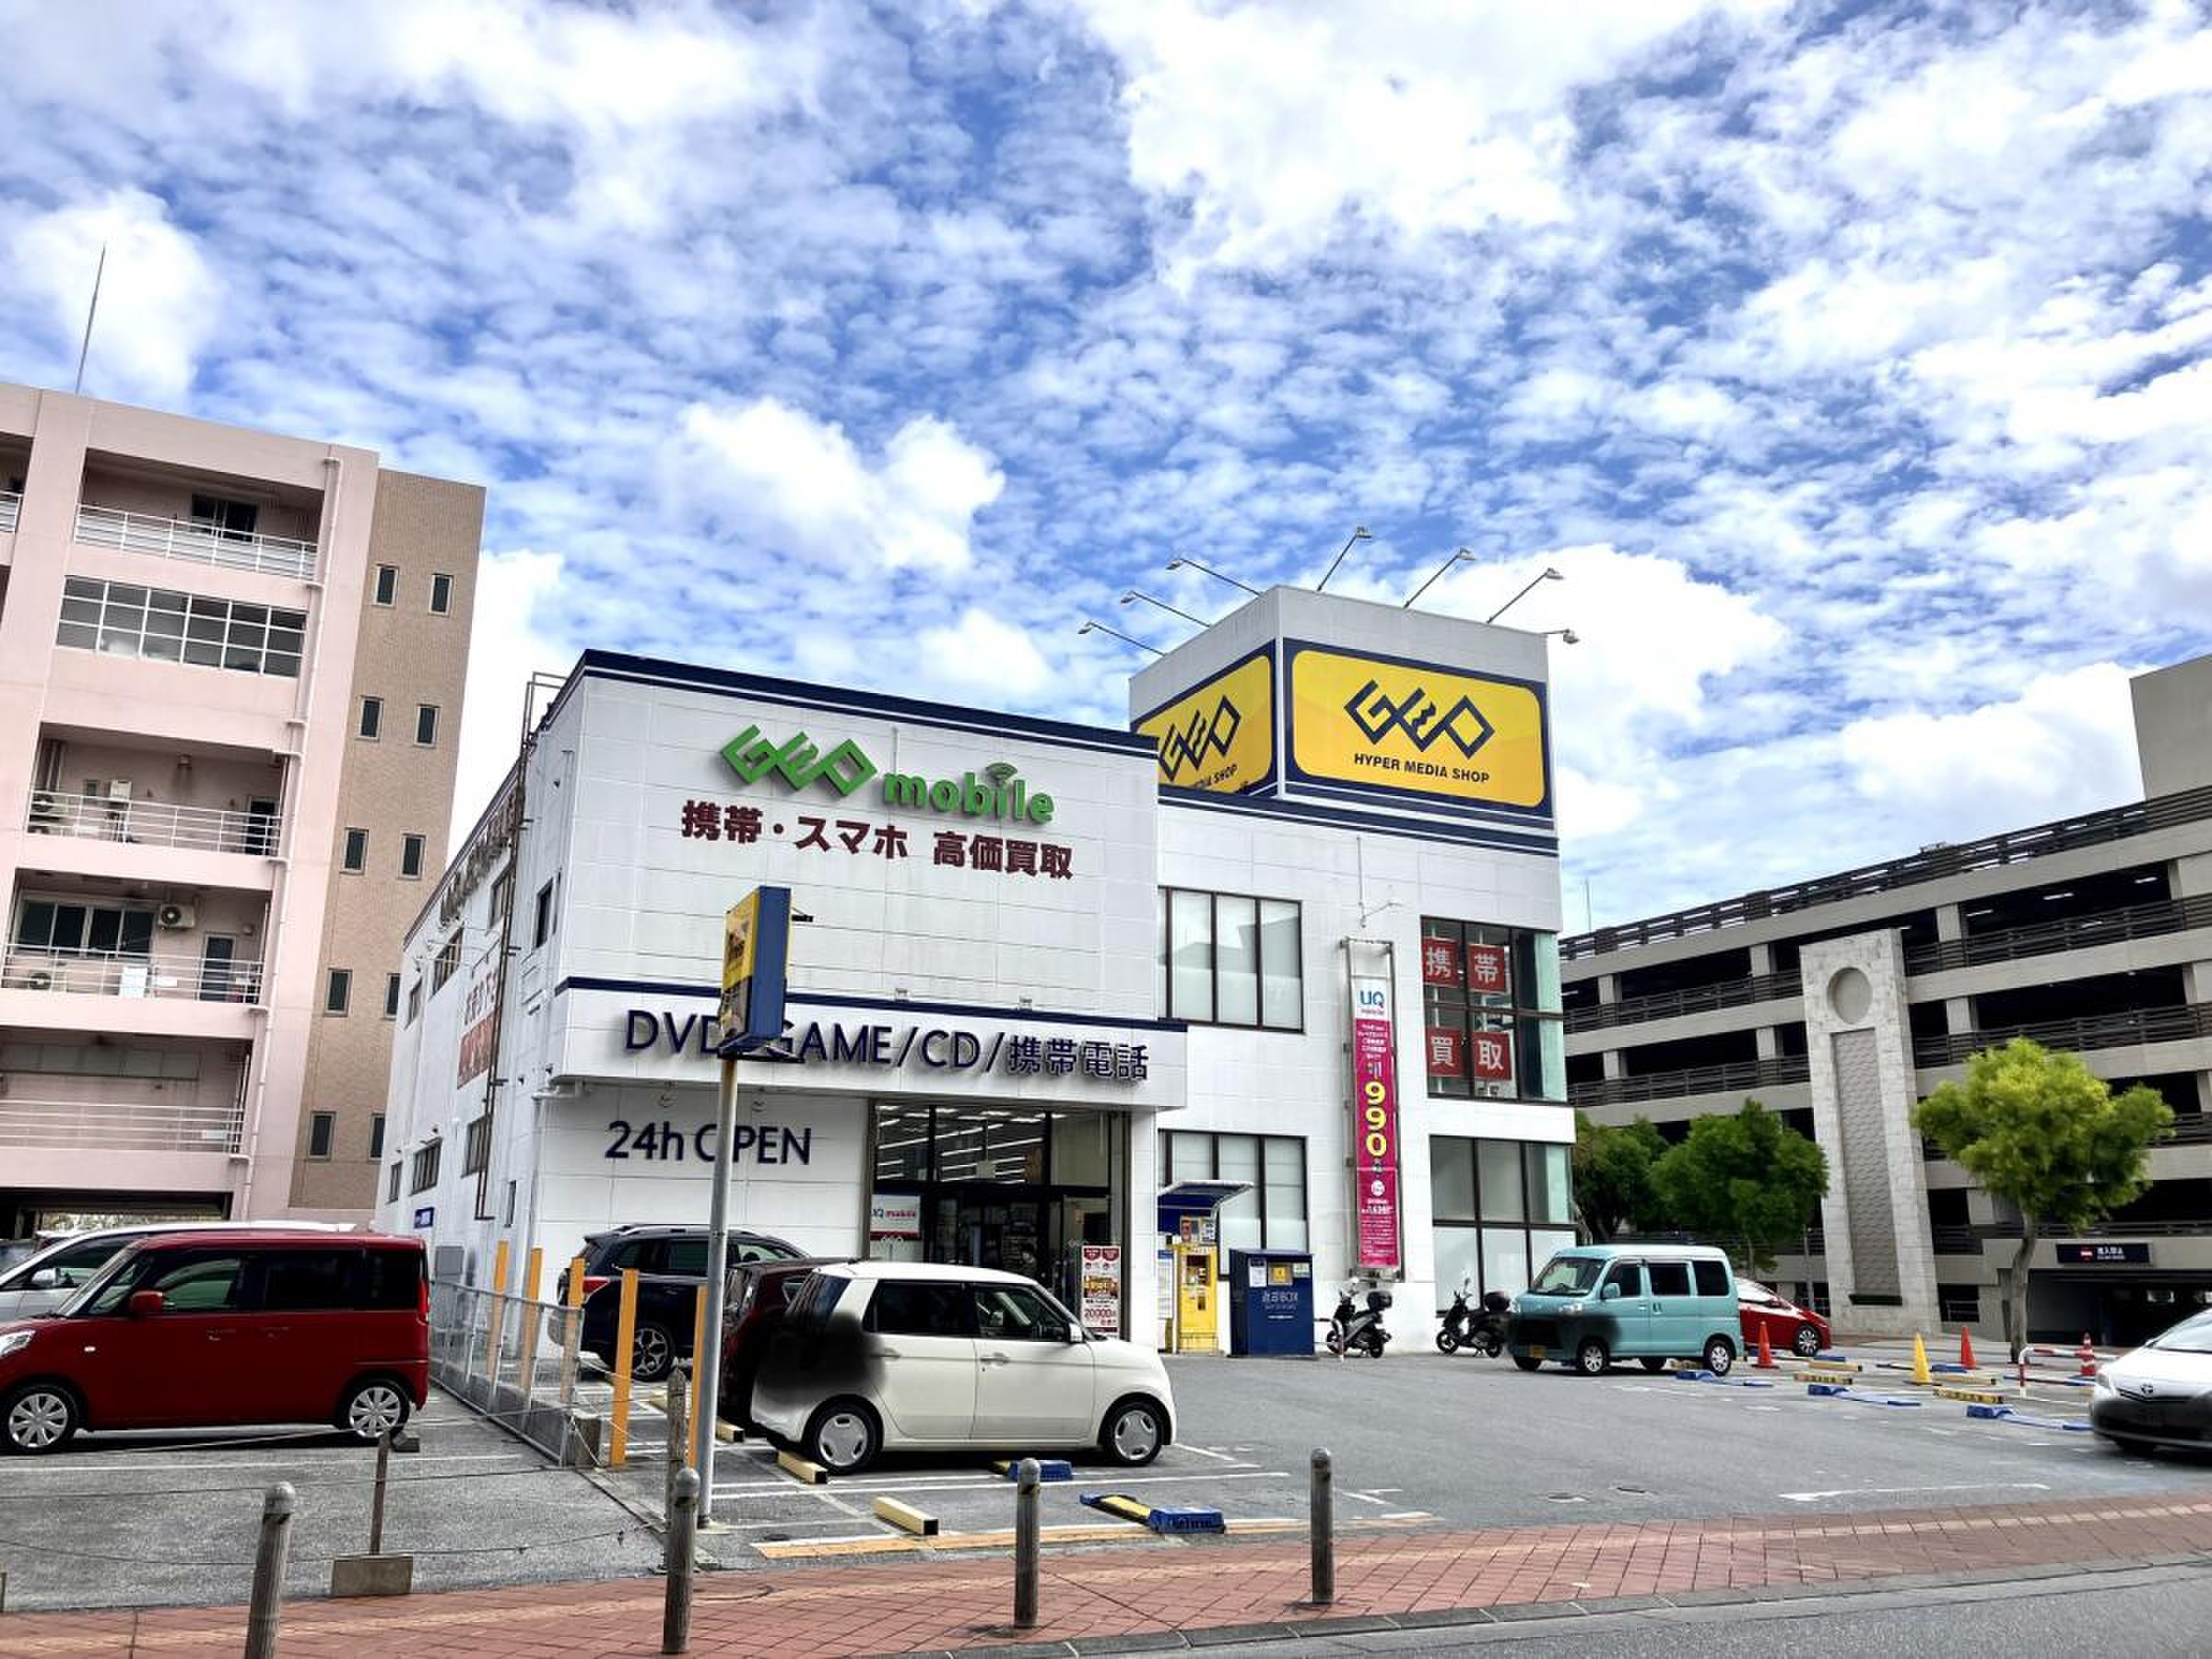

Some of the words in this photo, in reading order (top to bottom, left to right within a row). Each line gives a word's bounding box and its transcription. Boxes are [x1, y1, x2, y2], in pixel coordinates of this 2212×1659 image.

[1158, 695, 1241, 782] GEO
[1344, 678, 1495, 759] GEO
[721, 724, 878, 797] GEO
[884, 763, 1054, 825] mobile
[1354, 752, 1400, 771] HYPER
[1404, 760, 1447, 778] MEDIA
[1453, 768, 1490, 783] SHOP
[681, 799, 908, 859] 携帯・スマホ
[933, 830, 1074, 880] 高価買取
[1360, 990, 1385, 1008] UQ
[605, 1119, 684, 1161] 24h
[1365, 1081, 1387, 1157] 990
